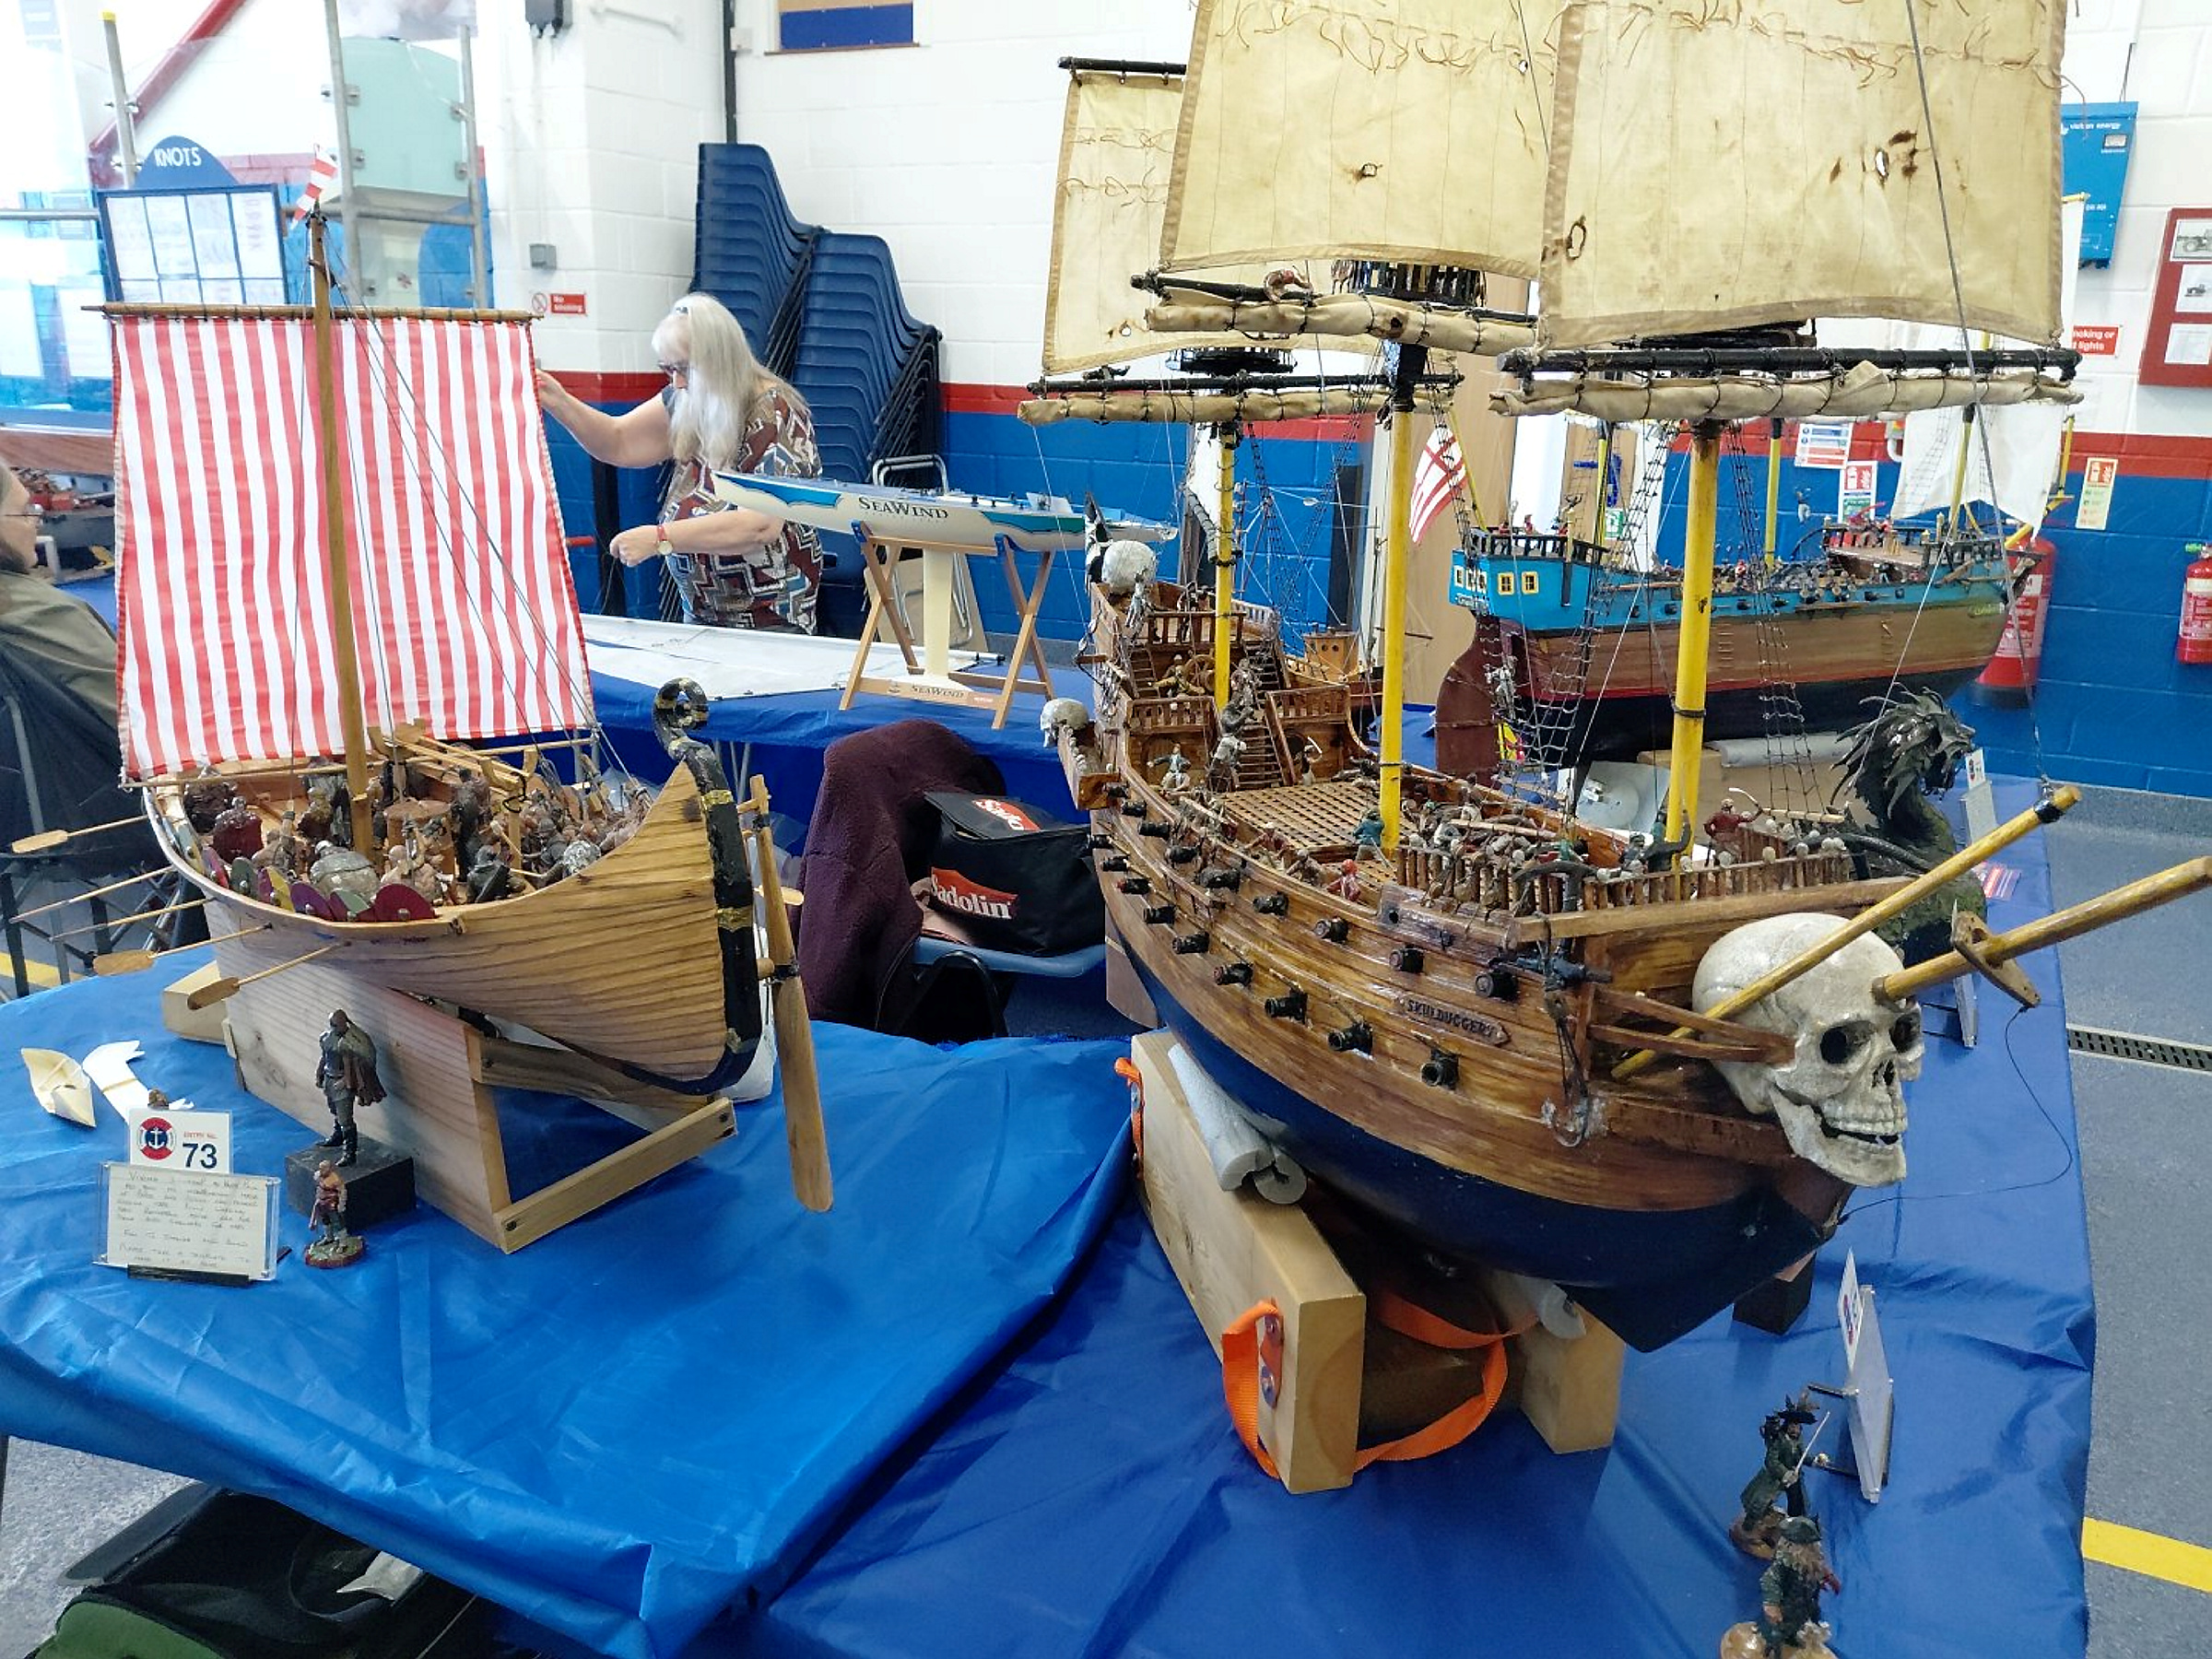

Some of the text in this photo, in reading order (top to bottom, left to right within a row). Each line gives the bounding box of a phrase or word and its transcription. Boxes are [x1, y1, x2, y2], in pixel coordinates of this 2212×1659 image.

[154, 147, 202, 167] KNOTS
[975, 799, 1025, 830] Sado
[931, 874, 1012, 920] Sadolin
[1406, 998, 1495, 1038] SKULDUGGERY
[182, 1143, 218, 1169] 73
